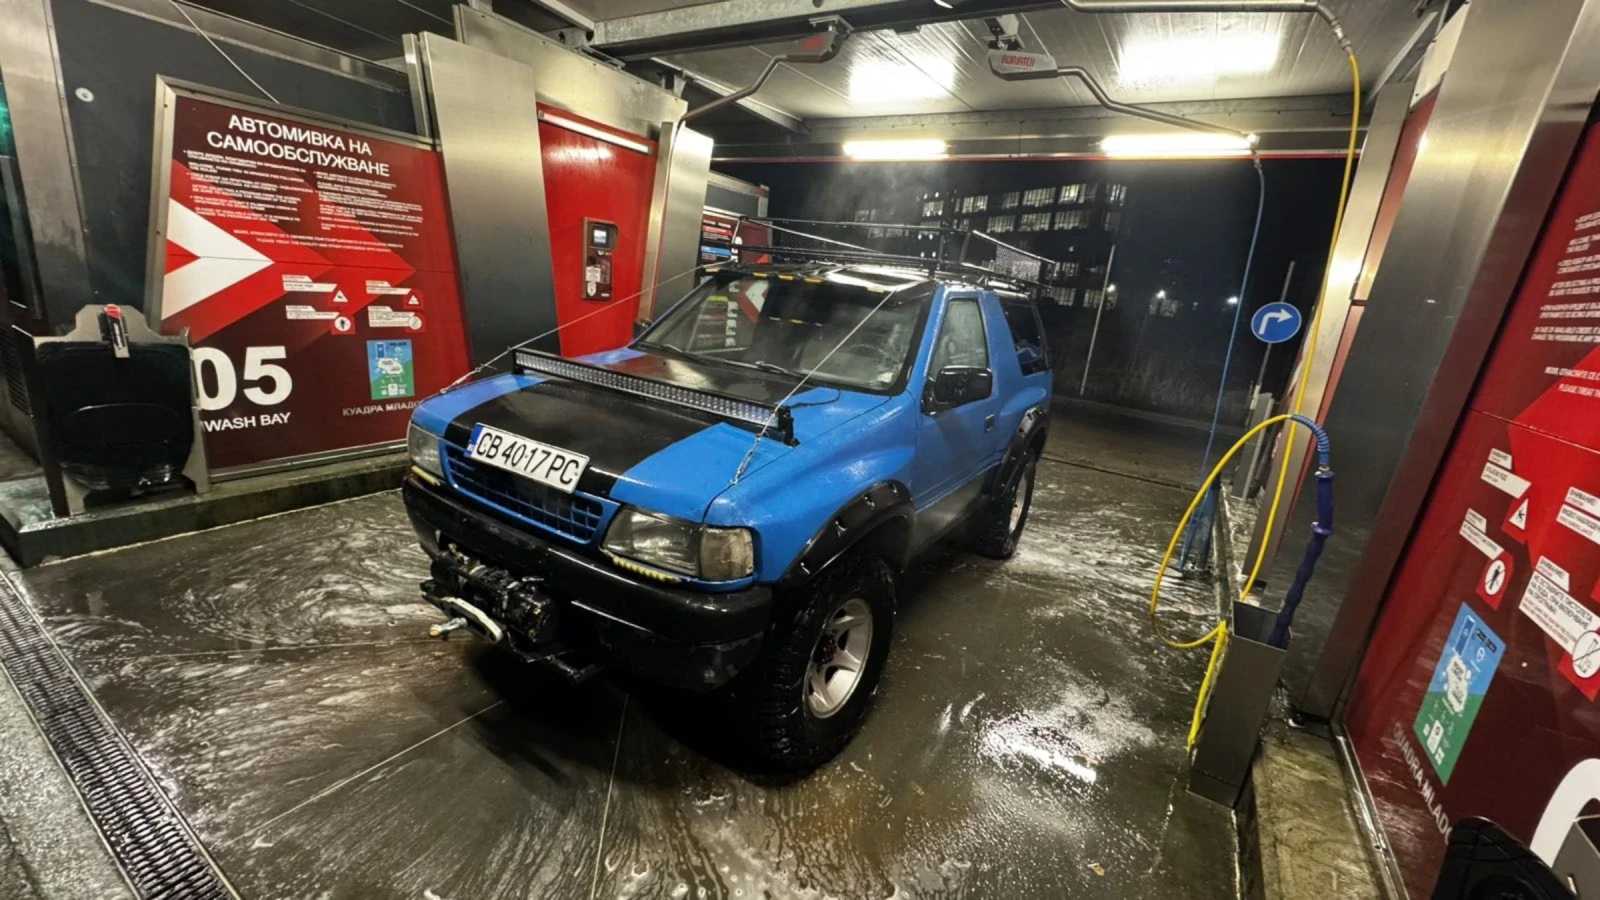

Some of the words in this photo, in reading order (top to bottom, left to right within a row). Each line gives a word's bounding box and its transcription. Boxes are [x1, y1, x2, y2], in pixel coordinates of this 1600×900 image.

[206, 131, 390, 177] САМООБСЛУЖВАНЕ
[228, 114, 345, 151] АВТОМИВКА
[345, 138, 373, 156] НА
[193, 346, 292, 410] 05
[204, 416, 256, 432] WASH
[260, 412, 291, 426] BAY
[342, 405, 384, 416] КУАДРА
[1394, 722, 1423, 787] QUADRA
